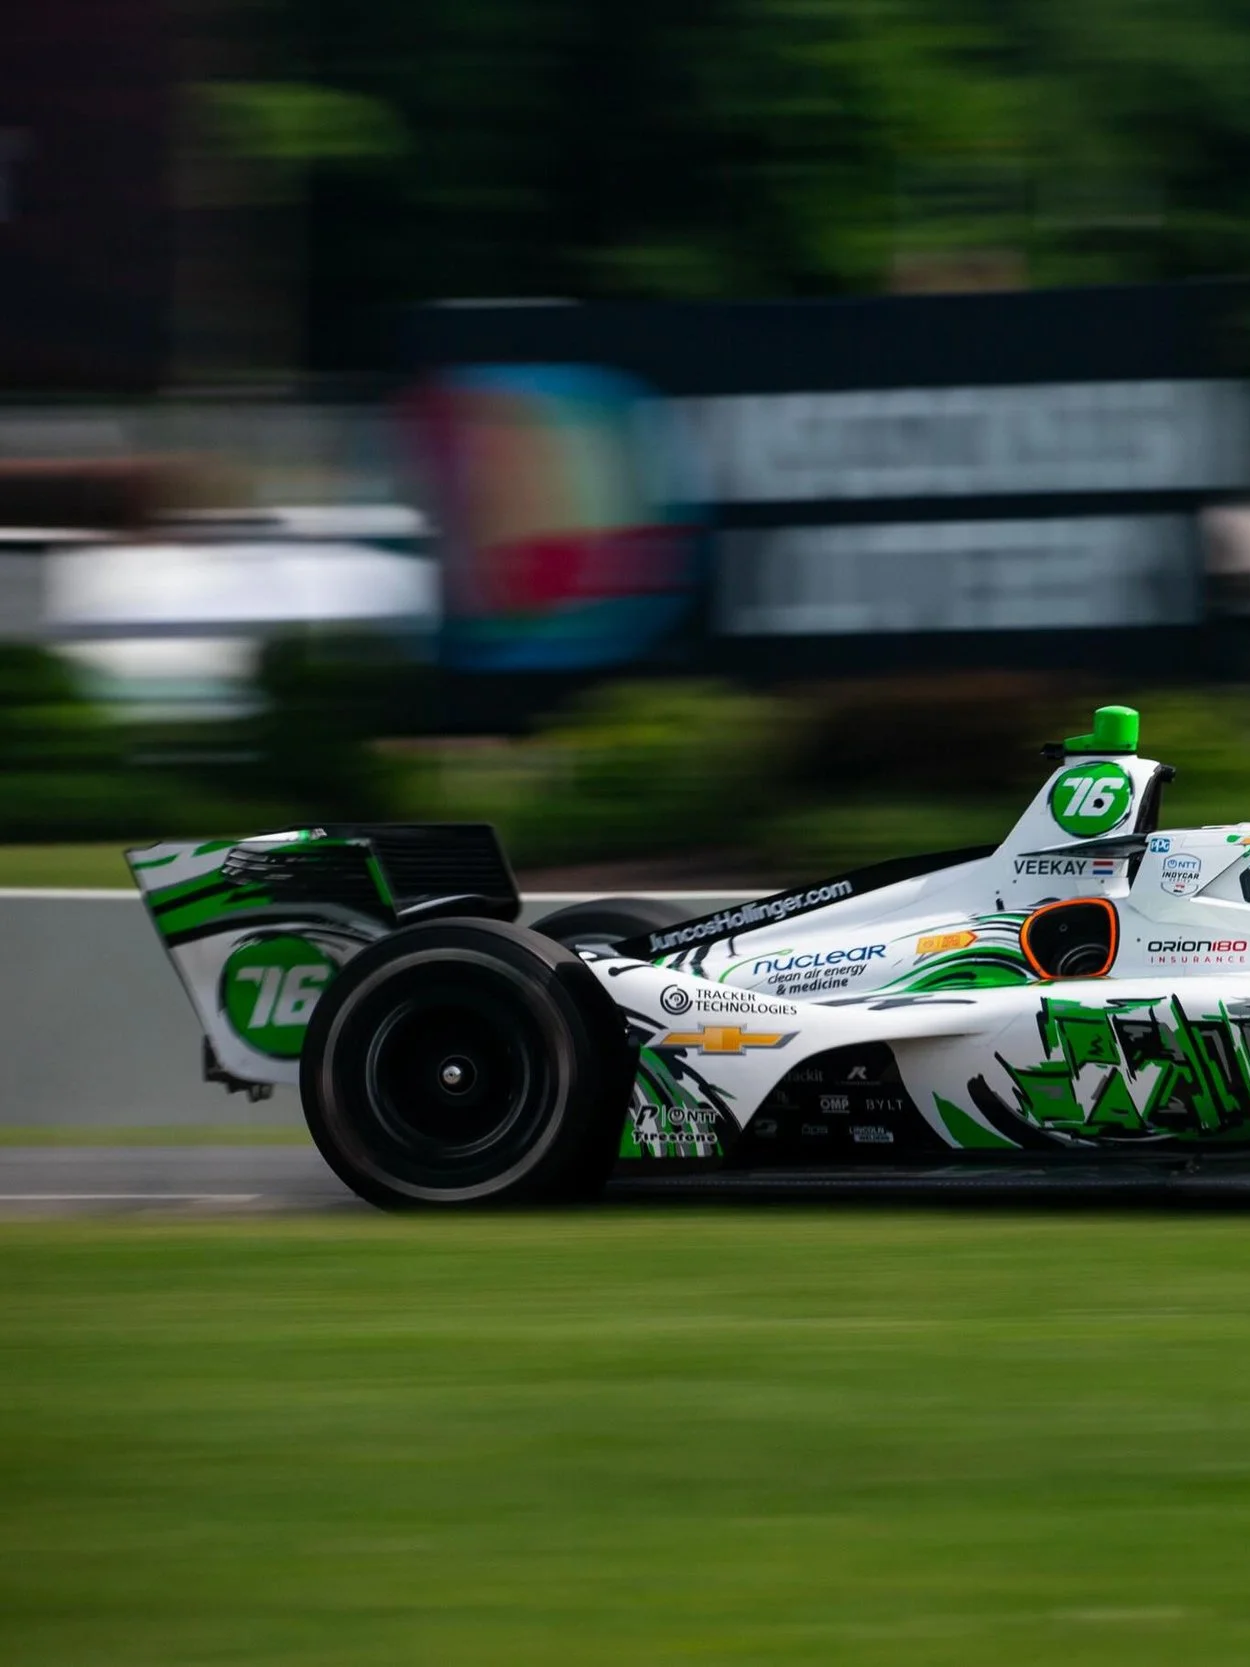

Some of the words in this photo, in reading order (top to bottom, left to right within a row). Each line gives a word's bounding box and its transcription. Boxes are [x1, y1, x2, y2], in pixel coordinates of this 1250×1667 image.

[1062, 777, 1125, 817] 76
[1151, 839, 1170, 852] PPG
[1014, 860, 1087, 875] VEEKAY
[1178, 861, 1197, 869] NTT
[1162, 871, 1200, 880] INDYCAR
[650, 879, 853, 952] JuncosHollinger.com
[1151, 956, 1245, 964] INSURANCE
[767, 971, 801, 986] clean
[803, 967, 822, 980] air
[823, 963, 868, 977] energy
[776, 984, 787, 996] &
[788, 977, 849, 995] medicine
[235, 964, 329, 1029] 76
[696, 989, 756, 1001] TRACKER
[696, 1001, 798, 1015] TECHNOLOGIES
[820, 1097, 850, 1109] OMP
[865, 1097, 904, 1111] BYLT
[686, 1109, 717, 1123] NTT
[632, 1130, 718, 1144] Firestone
